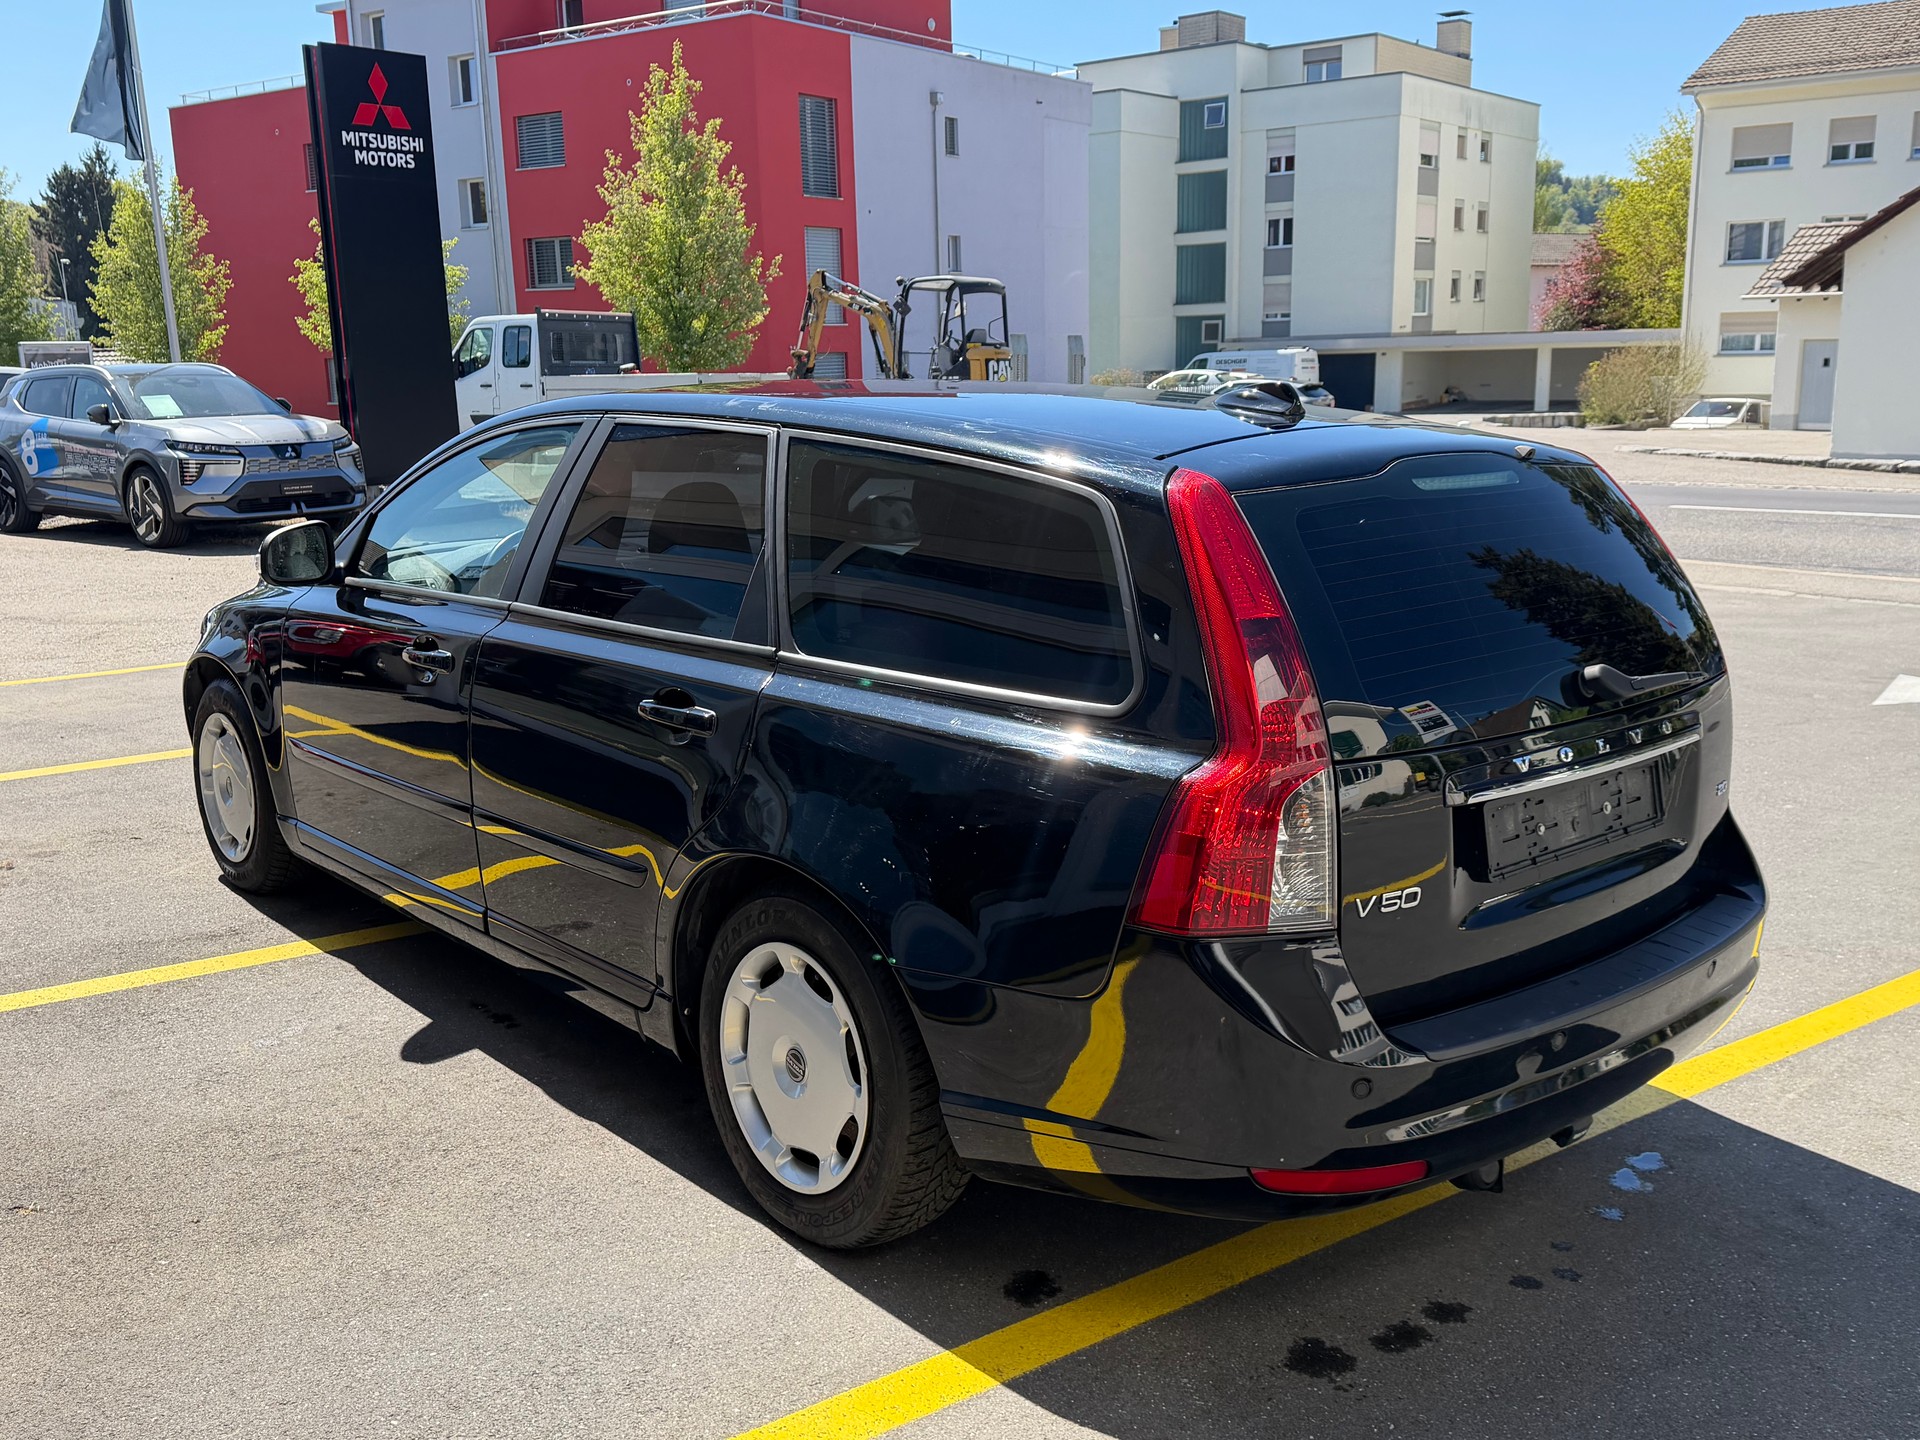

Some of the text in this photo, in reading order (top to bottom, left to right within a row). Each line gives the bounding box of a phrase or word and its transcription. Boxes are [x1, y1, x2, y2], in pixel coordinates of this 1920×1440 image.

[341, 130, 424, 153] MITSUBISHI
[354, 149, 416, 169] MOTORS
[988, 360, 1011, 381] CAT
[21, 429, 39, 475] 8
[1513, 719, 1673, 773] VOLVO
[1355, 886, 1422, 918] V50
[711, 908, 786, 978] DUNLOP
